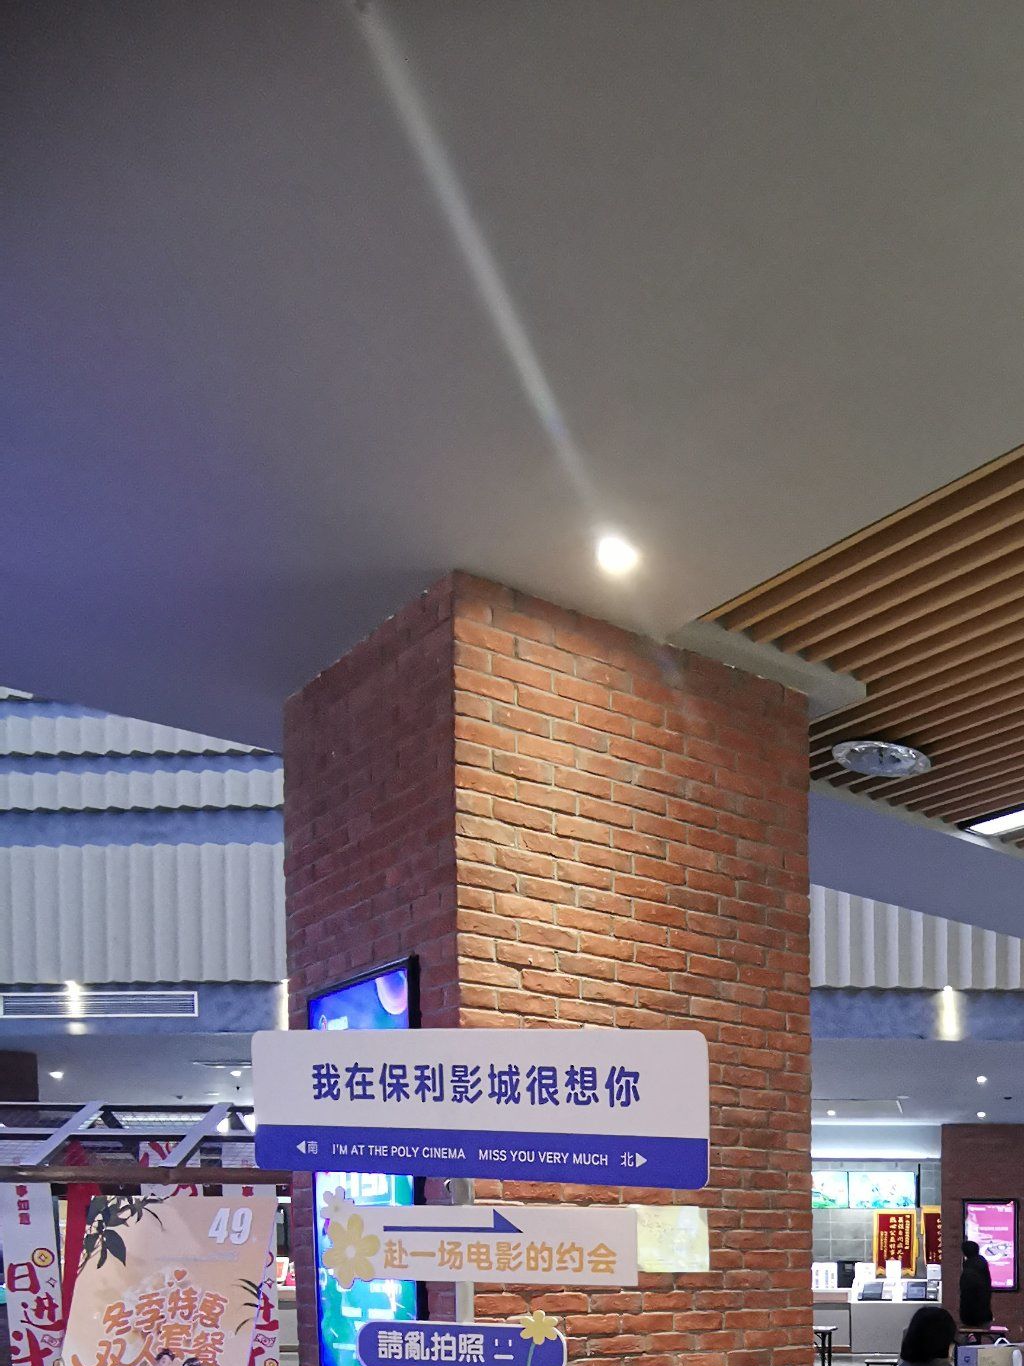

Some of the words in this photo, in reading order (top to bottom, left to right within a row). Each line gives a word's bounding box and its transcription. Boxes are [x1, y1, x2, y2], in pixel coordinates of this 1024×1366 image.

[311, 1061, 641, 1108] 我在保利影城很想你
[307, 1141, 319, 1155] 南
[332, 1143, 348, 1155] I'M
[351, 1144, 366, 1156] AT
[367, 1145, 389, 1157] THE
[390, 1146, 420, 1158] POLY
[422, 1147, 466, 1160] CINEMA
[478, 1149, 507, 1162] MISS
[509, 1150, 535, 1162] YOU
[537, 1151, 569, 1164] VERY
[572, 1153, 609, 1166] MUCH
[620, 1152, 634, 1167] 北
[207, 1207, 253, 1246] 49
[382, 1240, 618, 1275] 赴一场电影的约会
[102, 1286, 229, 1336] 冬季特惠
